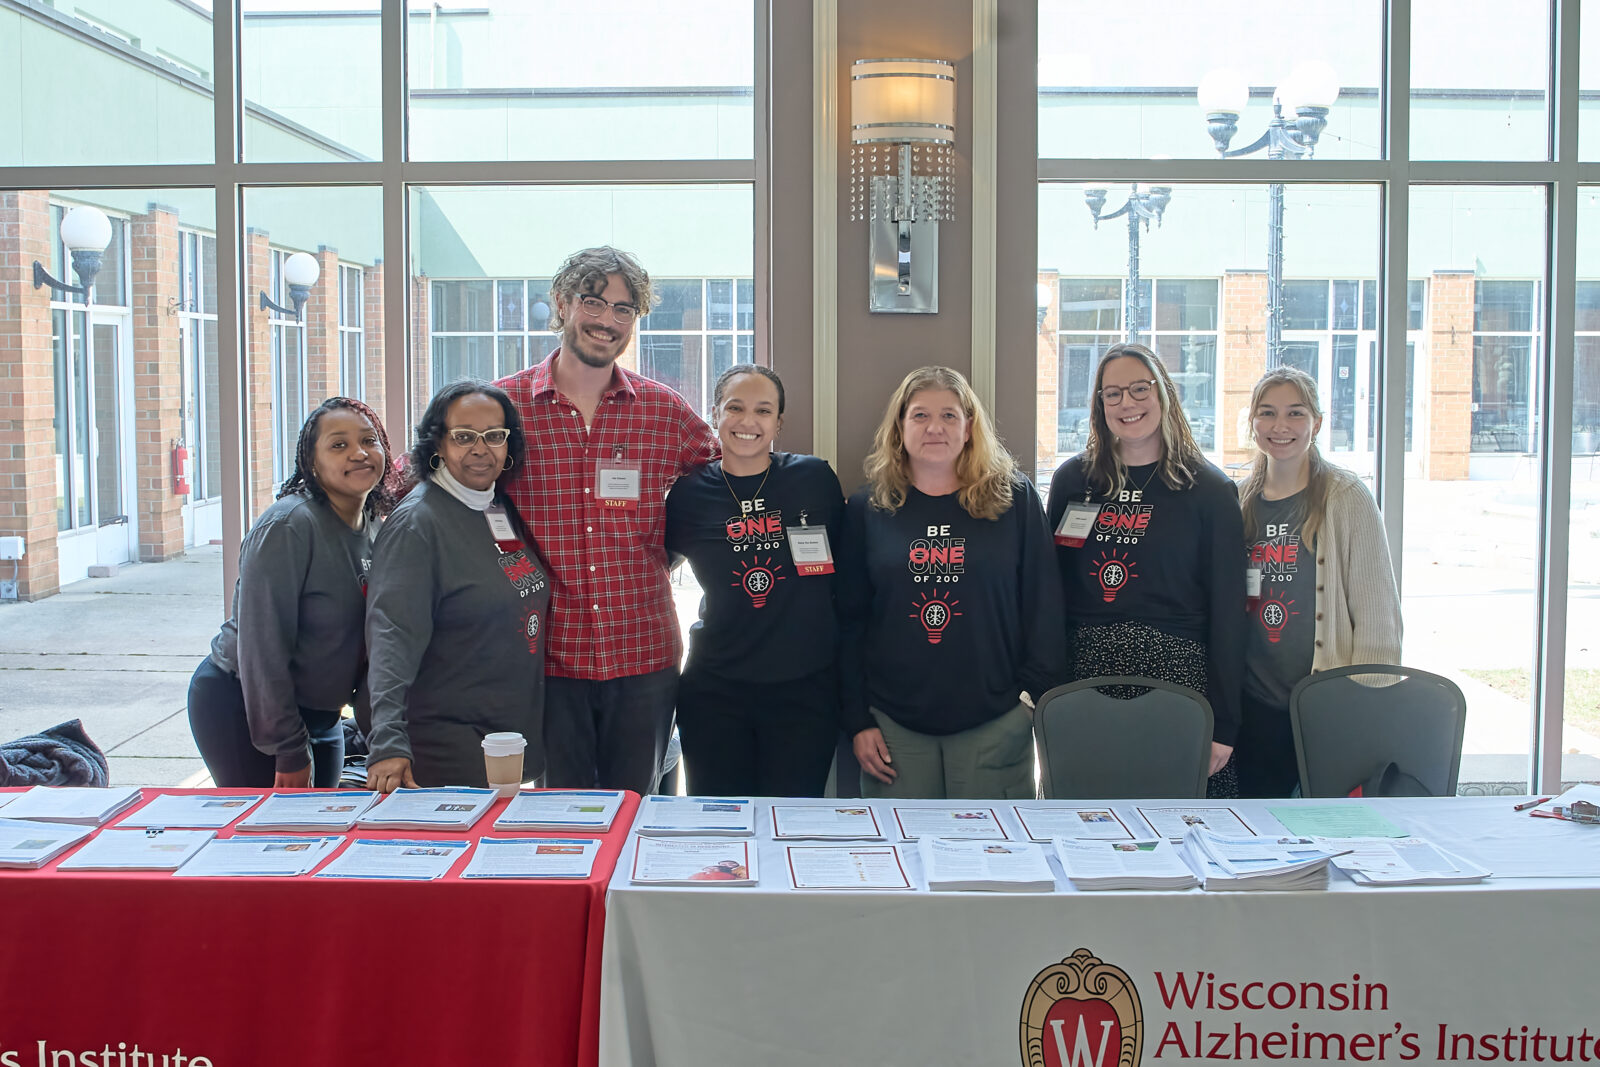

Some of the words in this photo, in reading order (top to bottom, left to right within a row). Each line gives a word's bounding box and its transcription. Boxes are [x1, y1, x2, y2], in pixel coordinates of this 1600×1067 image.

[1119, 490, 1143, 502] BE
[741, 498, 765, 513] BE
[1098, 511, 1152, 529] ONE
[726, 517, 782, 538] ONE
[927, 525, 951, 537] BE
[1266, 523, 1289, 537] BE
[1096, 534, 1112, 542] OF
[1116, 536, 1138, 545] 200
[733, 544, 750, 553] OF
[756, 542, 780, 551] 200
[1251, 544, 1299, 563] ONE
[909, 547, 965, 565] ONE
[804, 565, 825, 573] STAFF
[913, 575, 930, 583] OF
[936, 575, 959, 583] 200
[1271, 574, 1293, 582] 200
[520, 589, 529, 598] OF
[532, 581, 545, 593] 200
[1154, 971, 1388, 1011] Wisconsin
[1154, 1021, 1420, 1061] Alzheimer's
[1436, 1023, 1600, 1062] Institut
